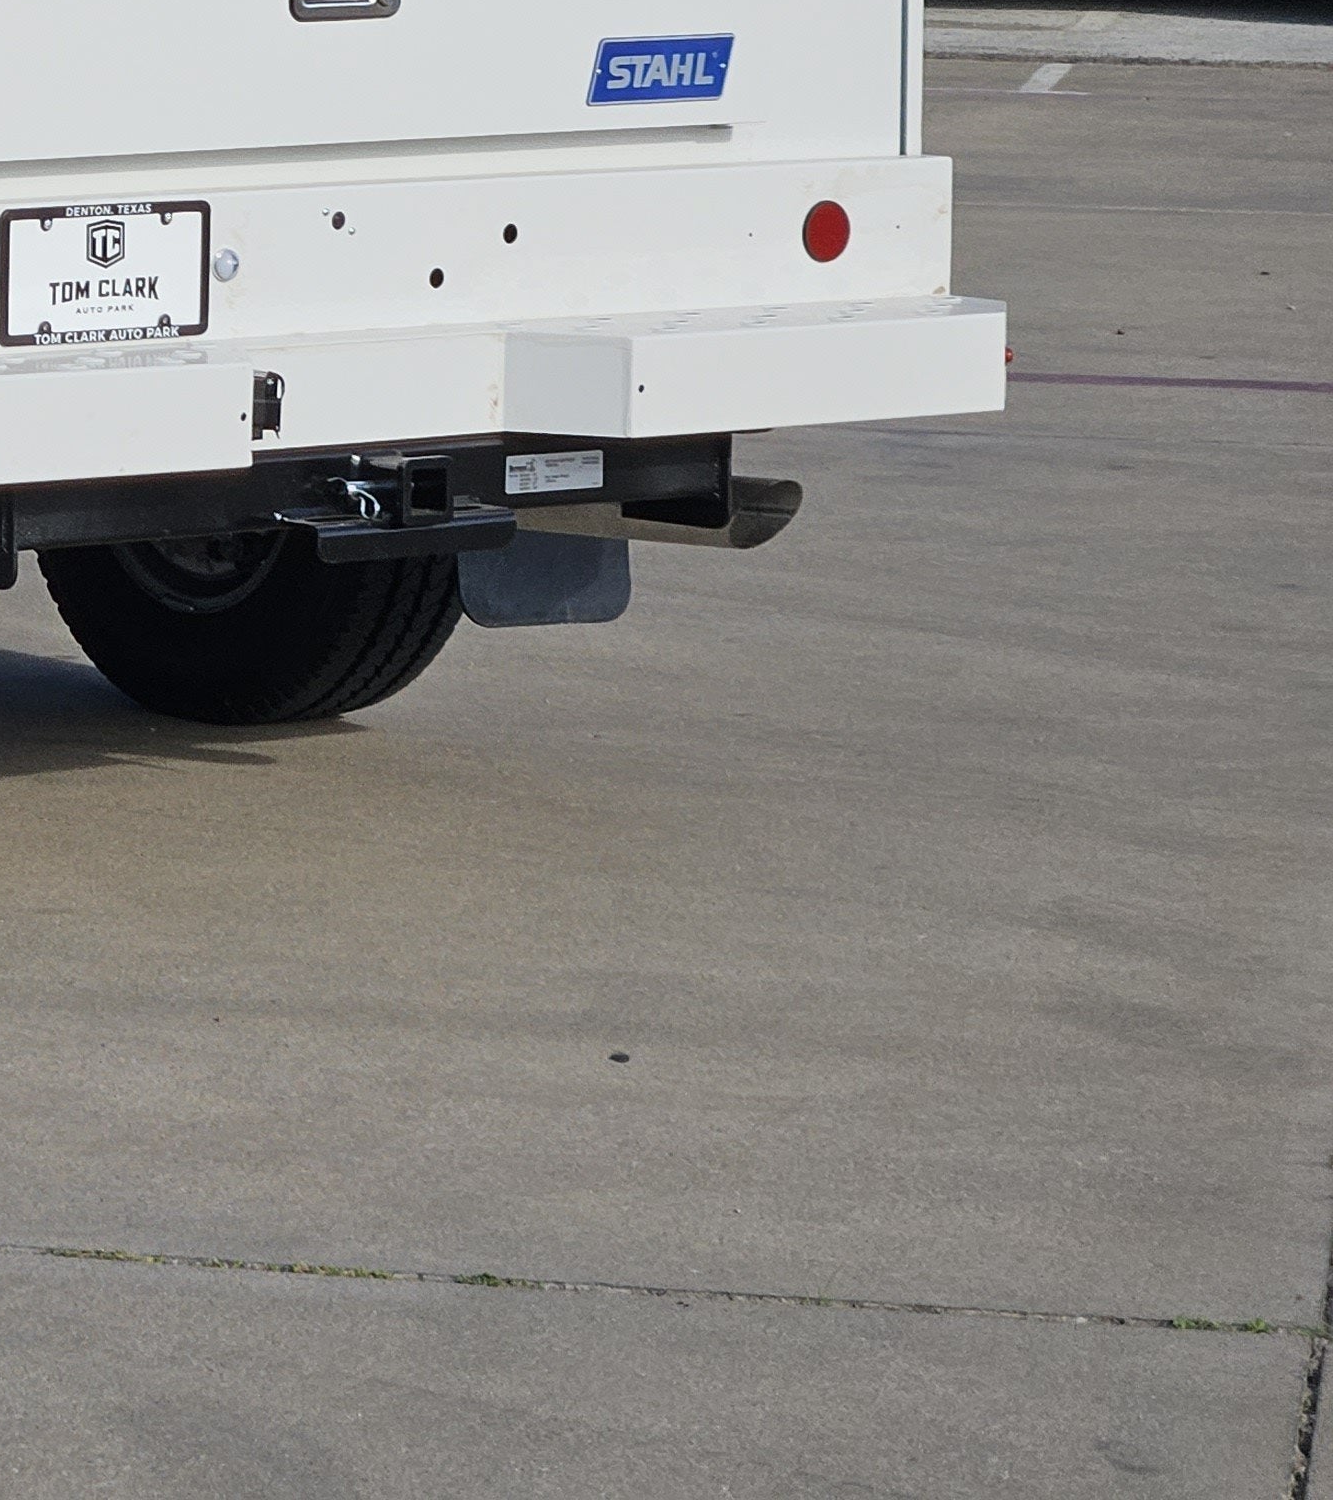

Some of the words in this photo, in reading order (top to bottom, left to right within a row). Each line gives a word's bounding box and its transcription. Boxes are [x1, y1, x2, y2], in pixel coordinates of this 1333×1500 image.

[606, 53, 715, 90] STAHL
[117, 203, 152, 215] TEXAS
[49, 280, 90, 305] TOM
[98, 276, 160, 300] CLARK
[75, 306, 103, 314] AUTO
[107, 304, 134, 312] PARK
[34, 332, 62, 346] TOM
[64, 329, 107, 344] CLARK
[109, 327, 143, 341] AUTO
[146, 325, 180, 339] PARK
